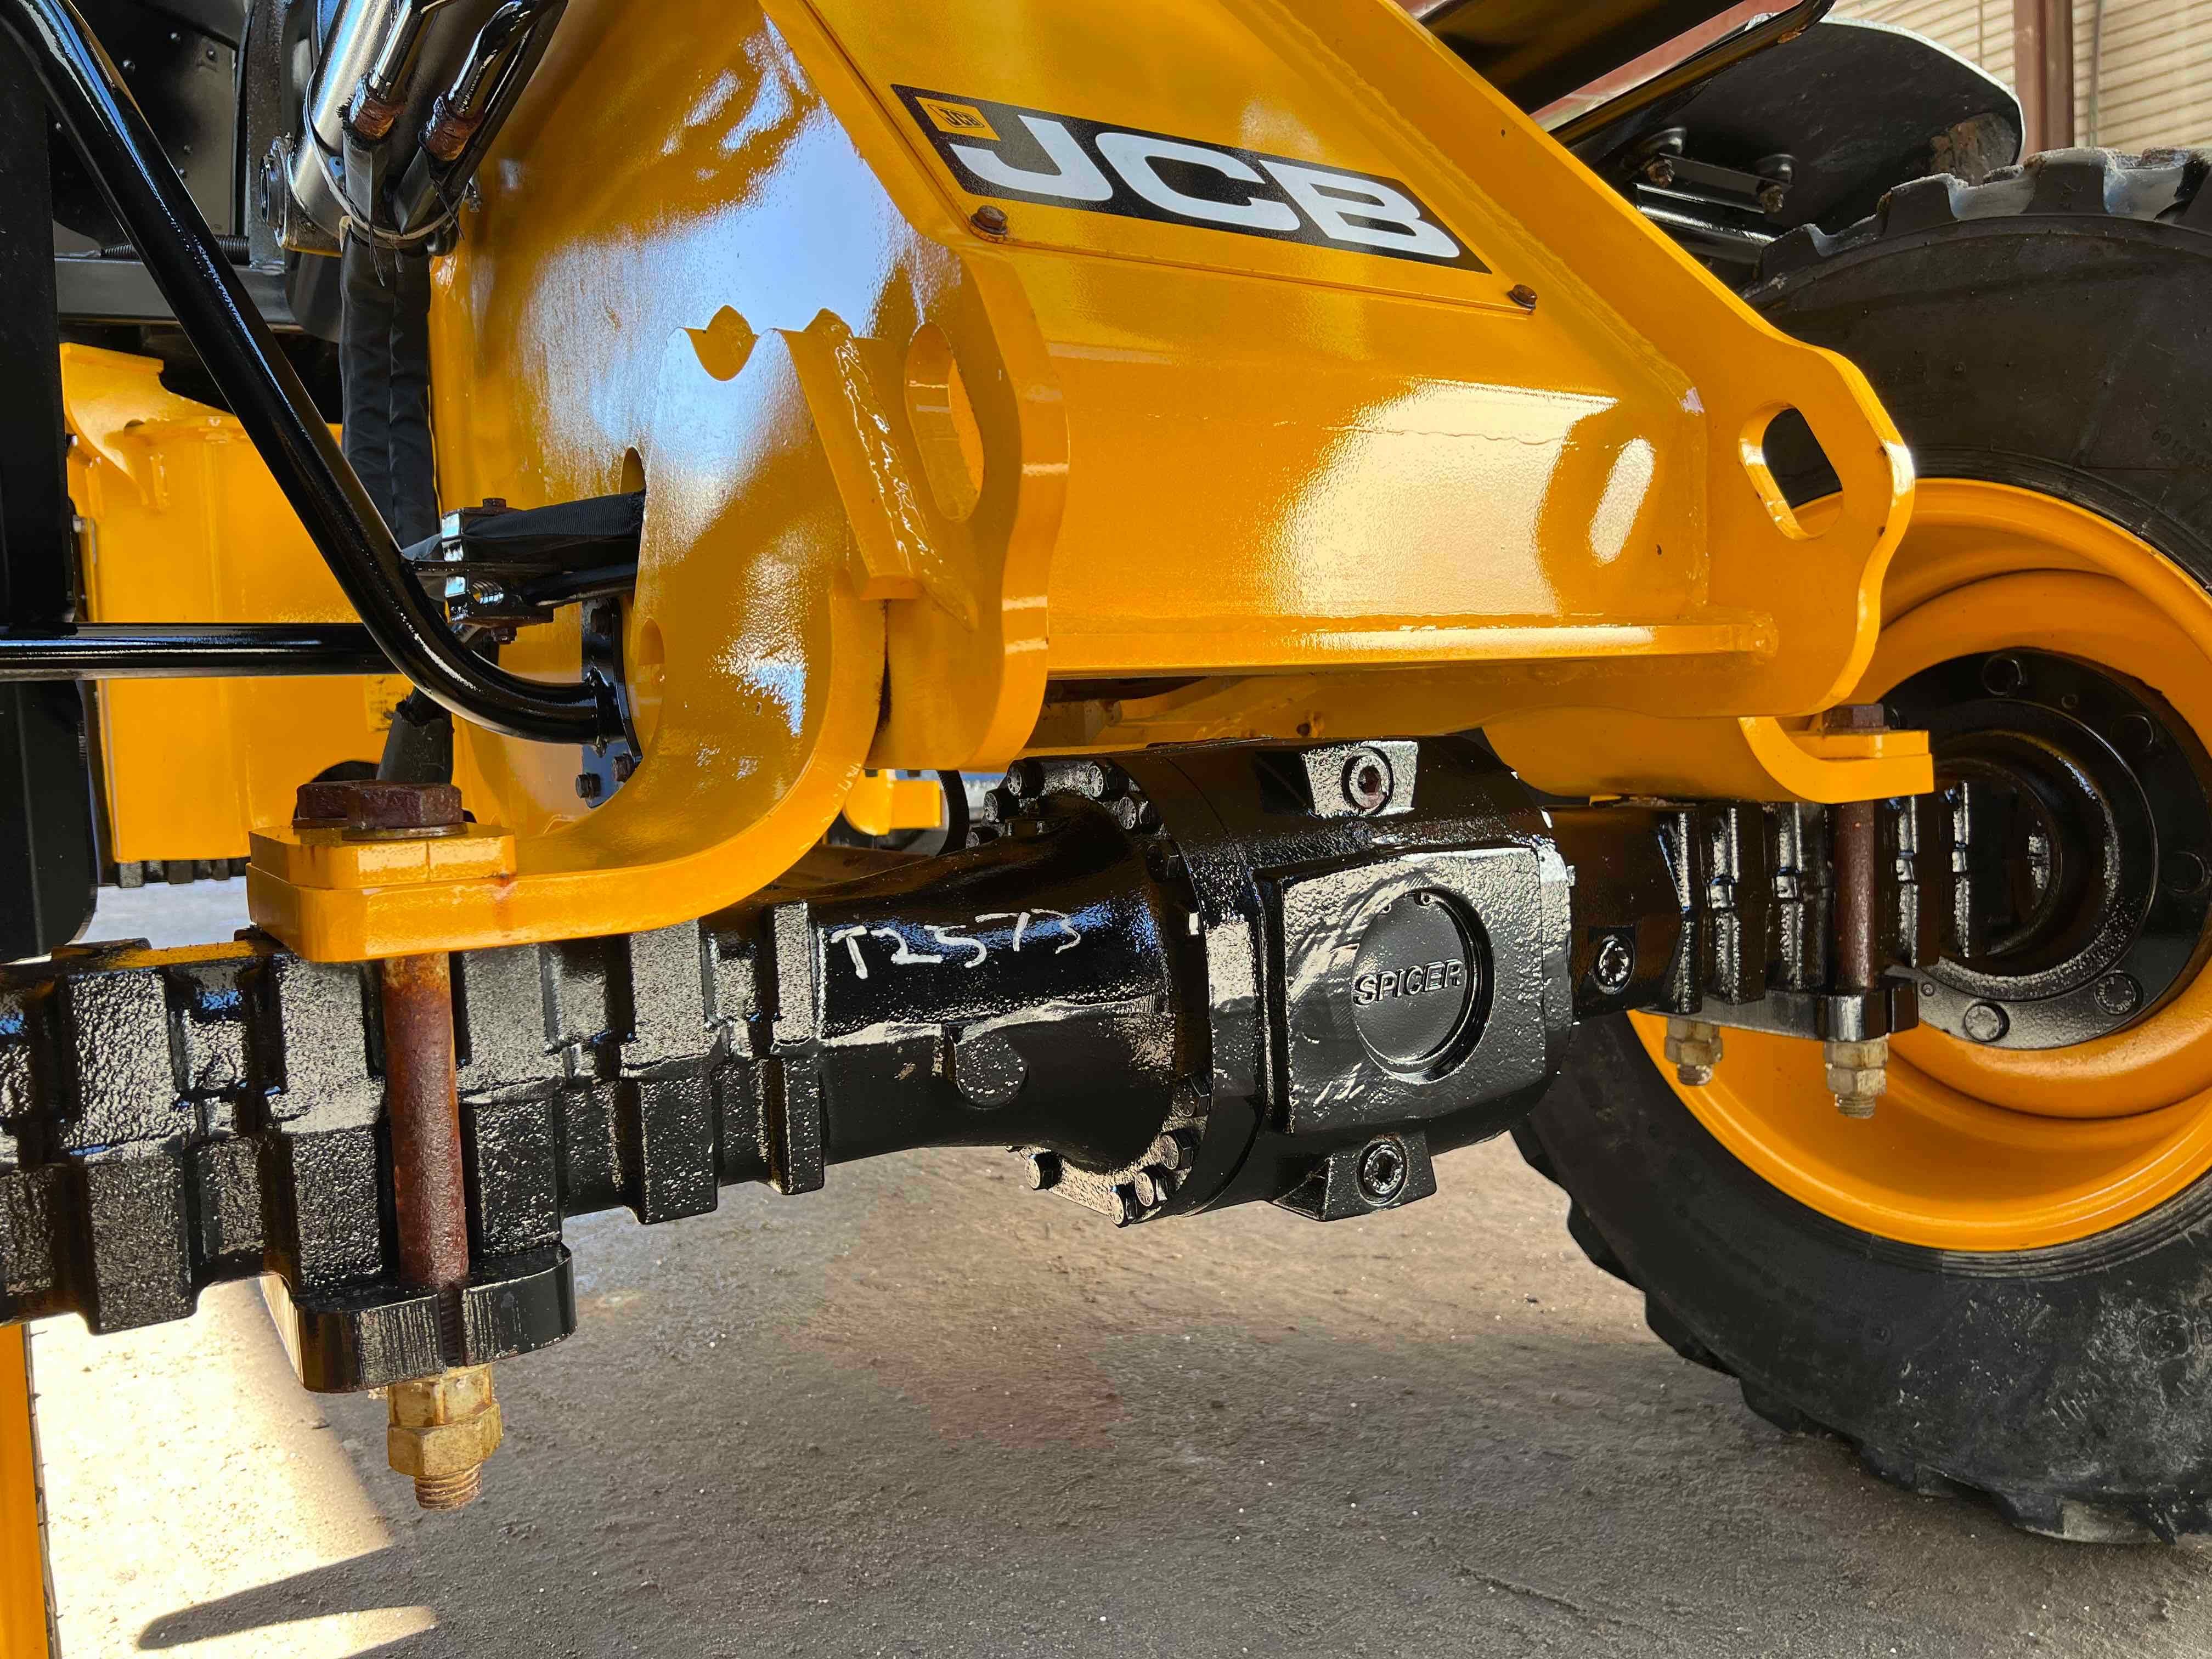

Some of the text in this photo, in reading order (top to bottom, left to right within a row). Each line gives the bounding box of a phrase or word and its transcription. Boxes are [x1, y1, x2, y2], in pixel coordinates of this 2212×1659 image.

[939, 108, 981, 126] JCB
[949, 114, 1461, 258] JCB
[831, 909, 1081, 979] T2573
[1352, 959, 1463, 1006] SPICER
